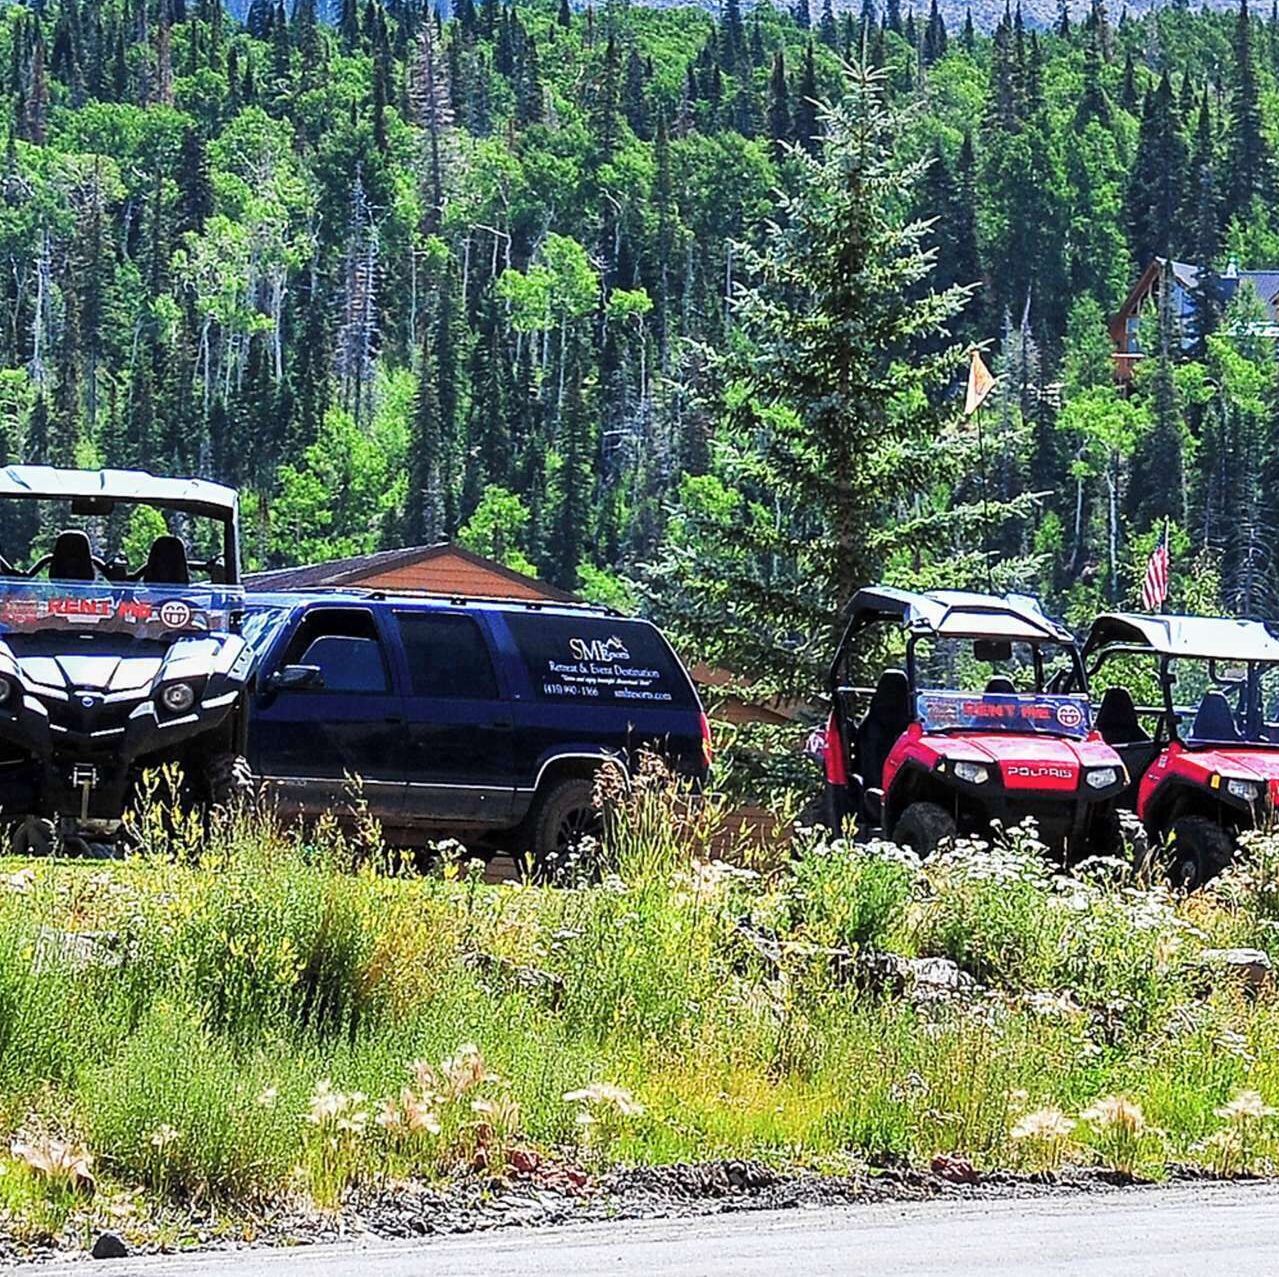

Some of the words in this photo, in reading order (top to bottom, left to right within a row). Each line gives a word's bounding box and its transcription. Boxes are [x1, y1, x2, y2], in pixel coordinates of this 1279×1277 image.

[48, 597, 109, 615] RENT
[962, 702, 1016, 717] RENT
[1020, 704, 1052, 720] ME
[1008, 766, 1072, 778] POLARIS
